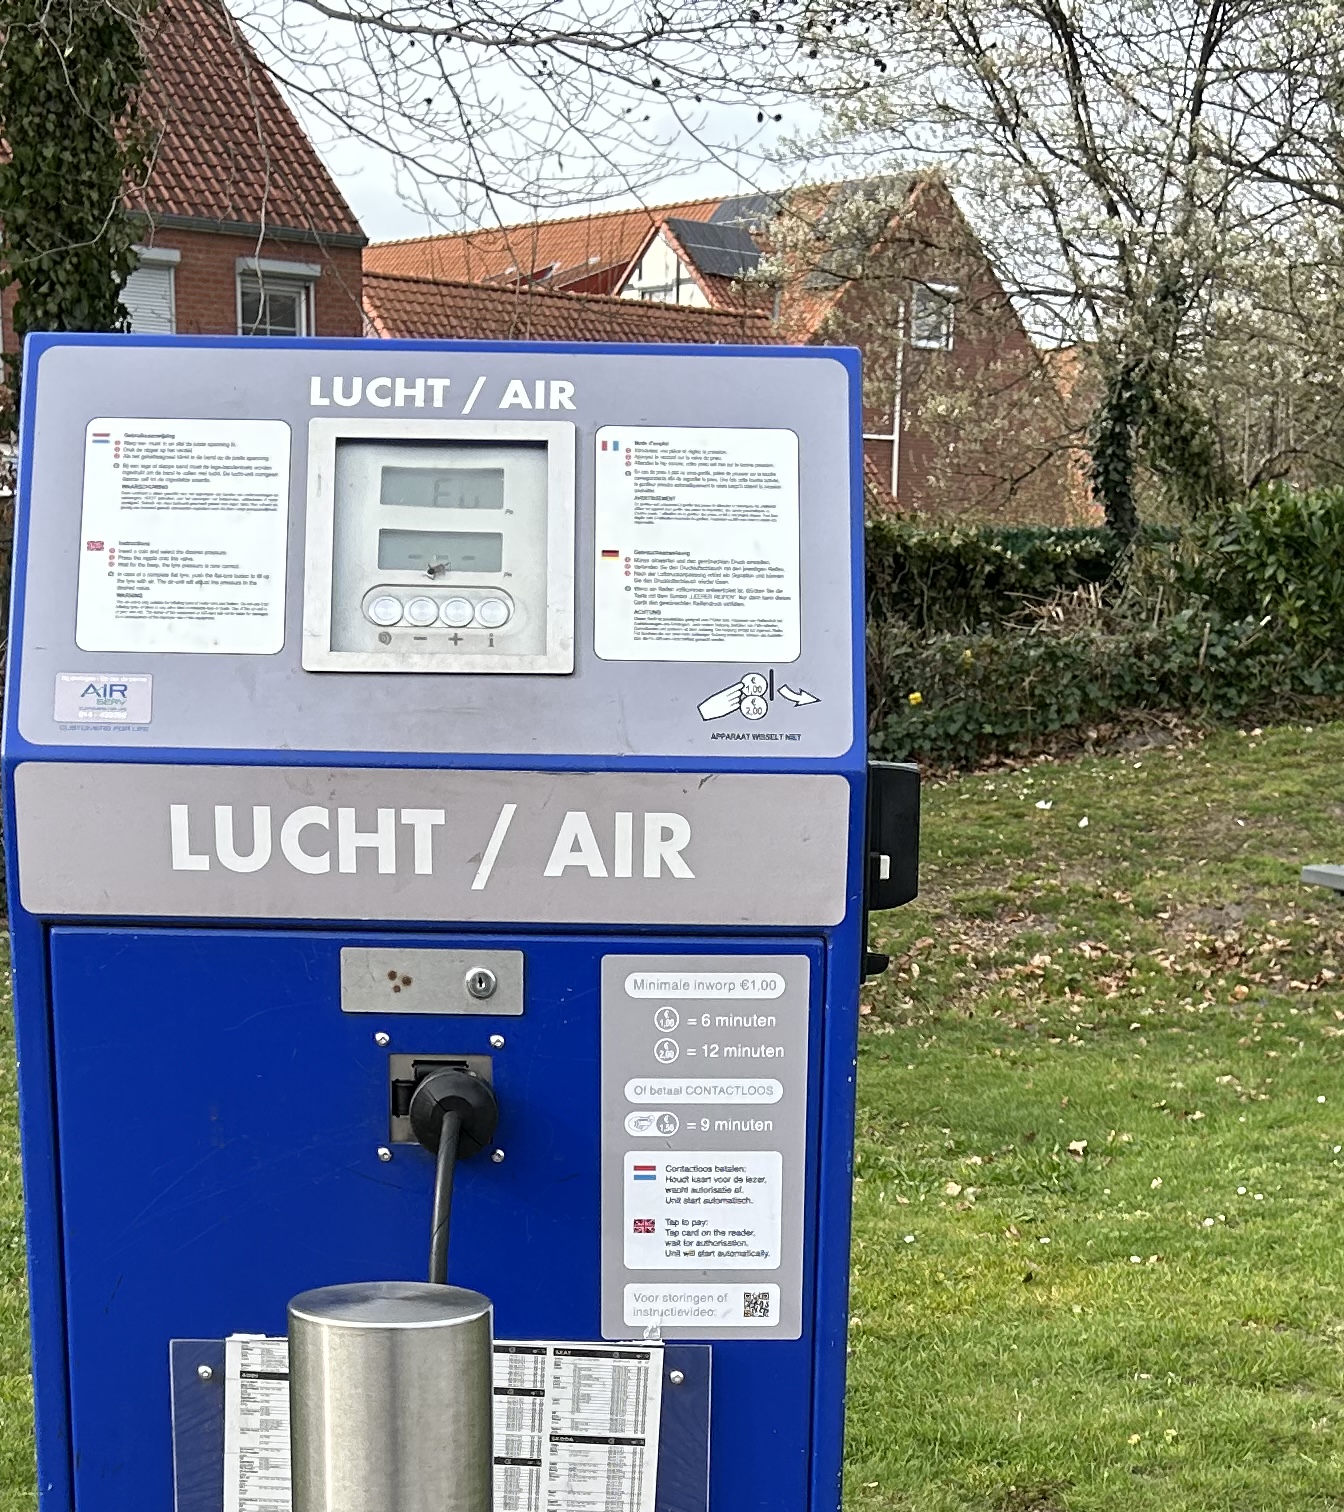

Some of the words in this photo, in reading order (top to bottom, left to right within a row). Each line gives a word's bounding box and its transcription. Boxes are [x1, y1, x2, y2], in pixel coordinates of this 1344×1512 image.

[310, 376, 450, 408] LUCHT
[461, 376, 487, 415] /
[498, 379, 577, 410] AIR
[80, 683, 128, 698] AIR
[170, 804, 446, 875] LUCHT
[471, 803, 518, 891] /
[543, 811, 696, 879] AIR
[633, 979, 690, 991] Minimale
[701, 1013, 711, 1027] 6
[715, 1013, 776, 1028] minuten
[702, 1044, 719, 1058] 12
[723, 1044, 784, 1058] minuten
[634, 1085, 647, 1096] Of
[650, 1085, 682, 1096] betaal
[685, 1085, 774, 1096] CONTACTLOOS
[700, 1118, 710, 1132] 9
[714, 1118, 773, 1132] minuten
[665, 1218, 679, 1227] Tap
[665, 1229, 679, 1237] Tap
[633, 1293, 659, 1302] Voor
[662, 1292, 714, 1305] storingen
[717, 1293, 729, 1302] of
